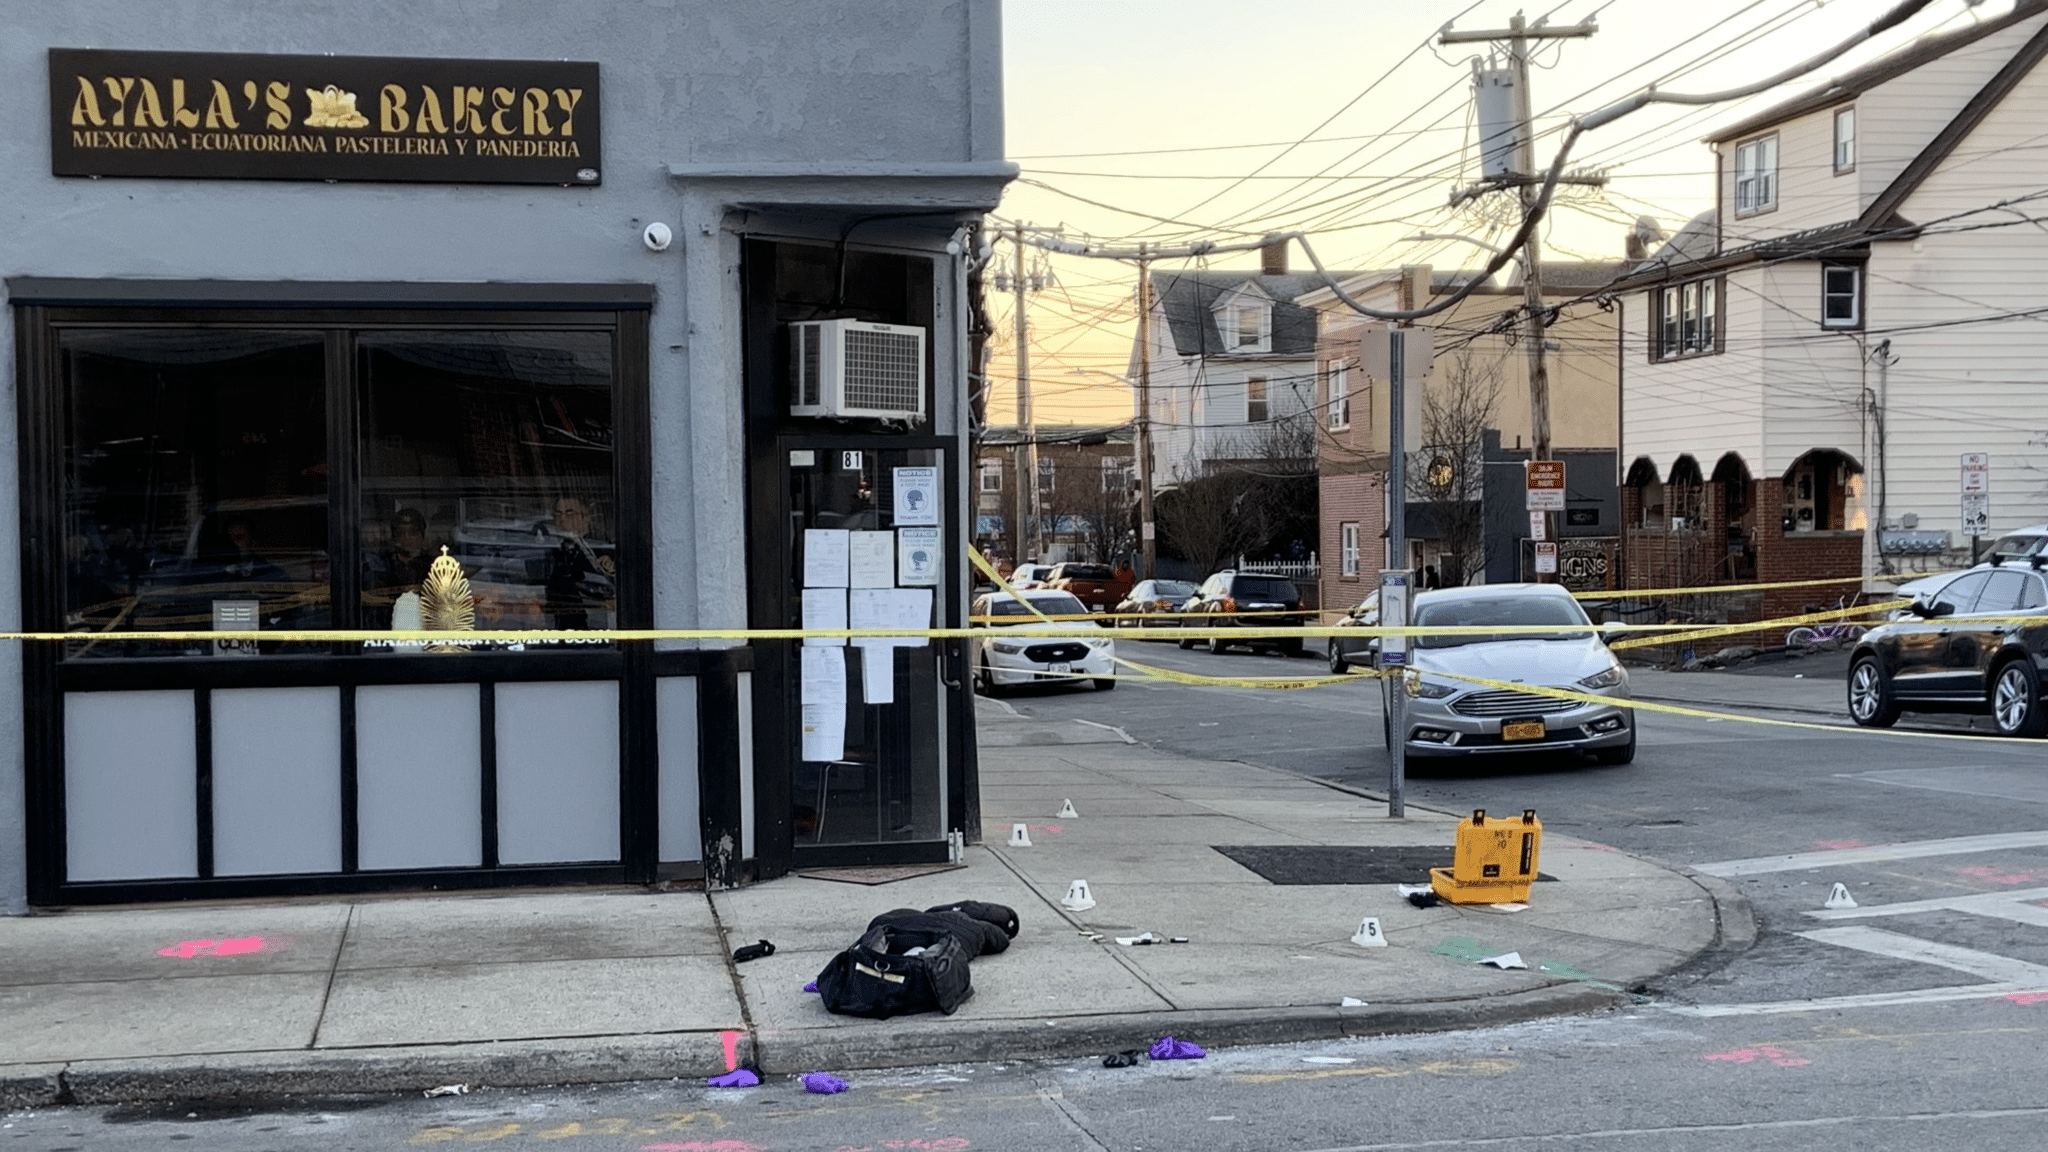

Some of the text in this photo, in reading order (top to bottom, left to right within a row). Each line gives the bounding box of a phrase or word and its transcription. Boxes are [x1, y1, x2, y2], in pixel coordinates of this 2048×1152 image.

[72, 76, 583, 136] AYALA'S BAKERY
[335, 136, 449, 156] PASTELERIA
[455, 138, 469, 156] Y
[476, 139, 581, 158] PANEDERIA
[844, 452, 860, 468] 81
[1560, 557, 1608, 577] IGNS
[1368, 922, 1376, 936] 5
